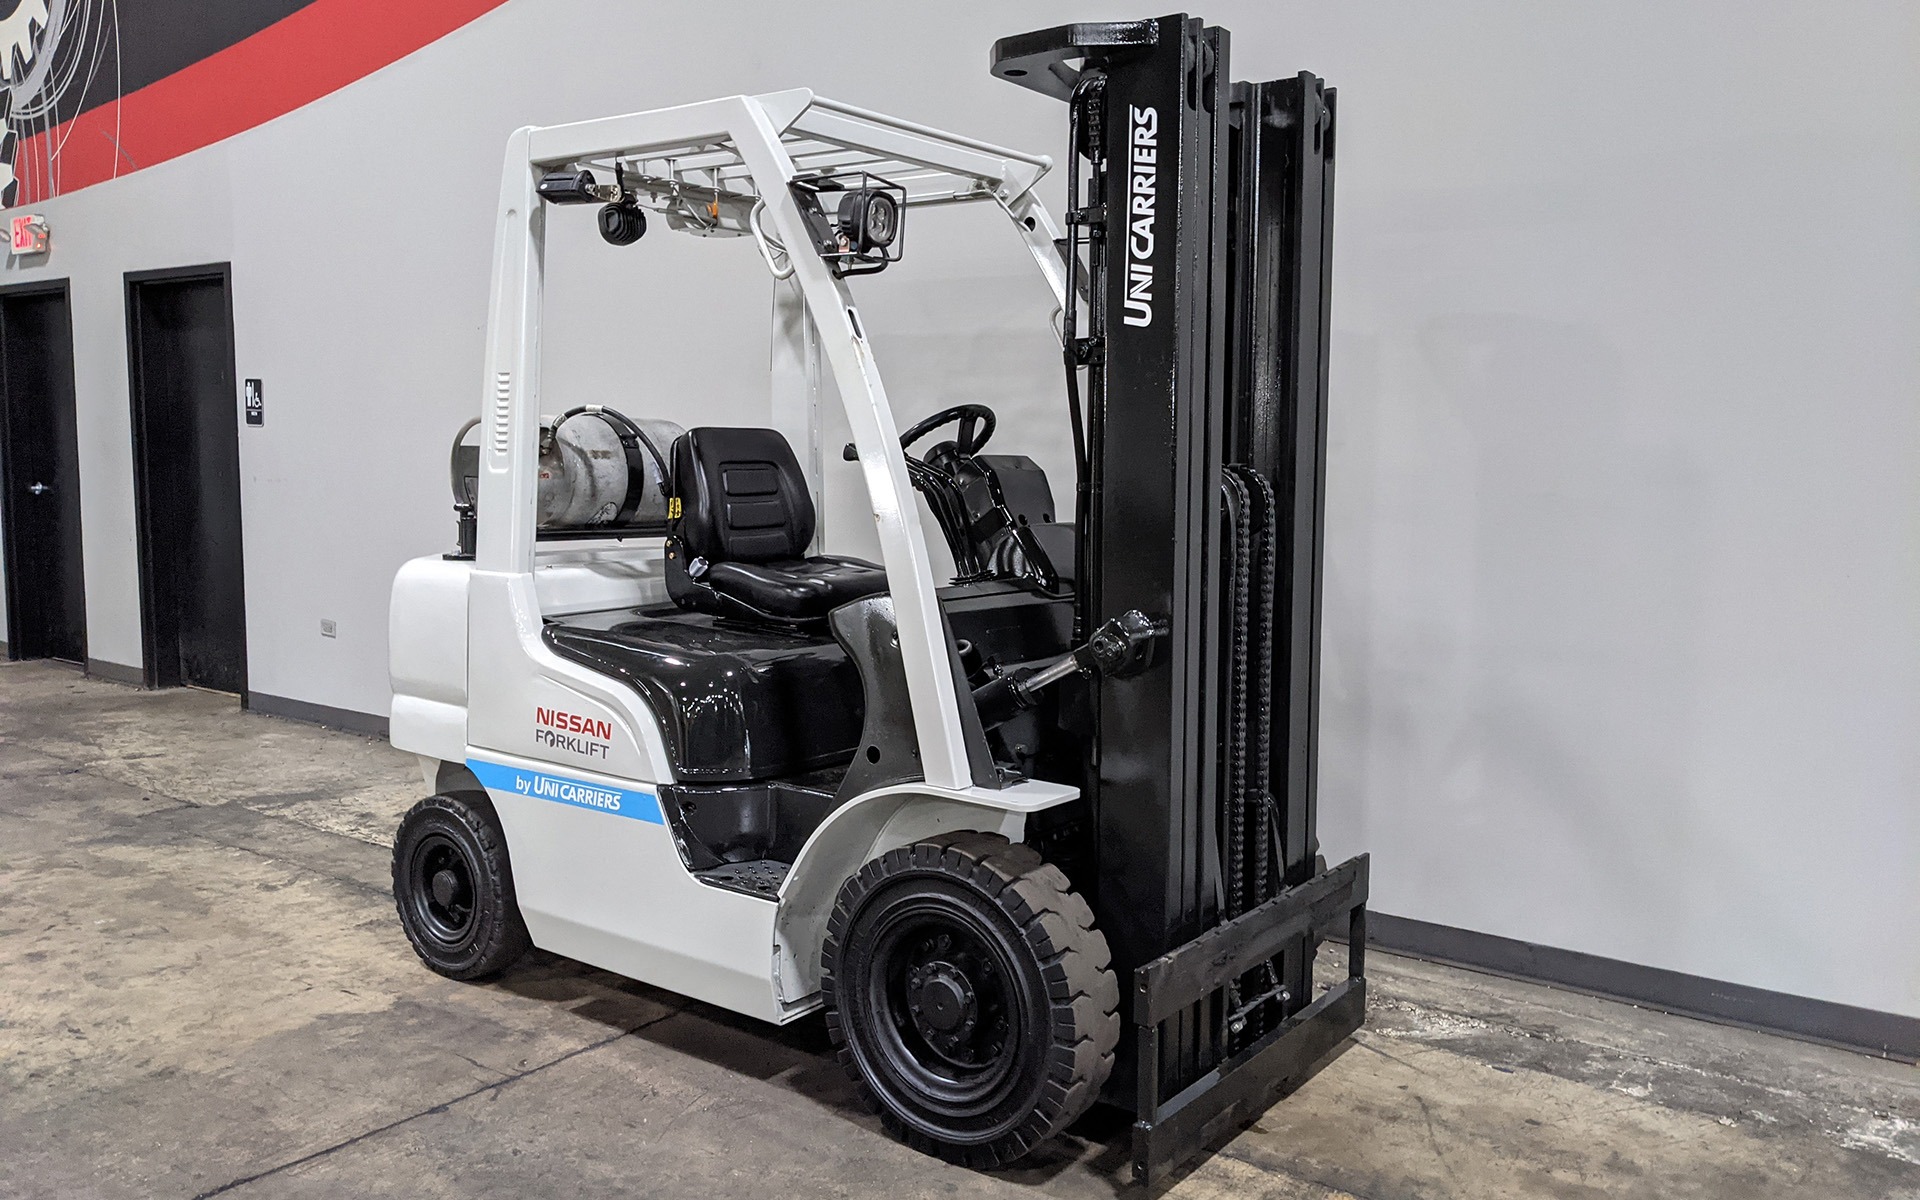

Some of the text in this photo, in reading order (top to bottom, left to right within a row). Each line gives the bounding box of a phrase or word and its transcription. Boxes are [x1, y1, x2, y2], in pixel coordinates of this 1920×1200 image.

[536, 706, 612, 740] NISSAN
[535, 728, 610, 760] FORKLIFT
[515, 775, 531, 795] by
